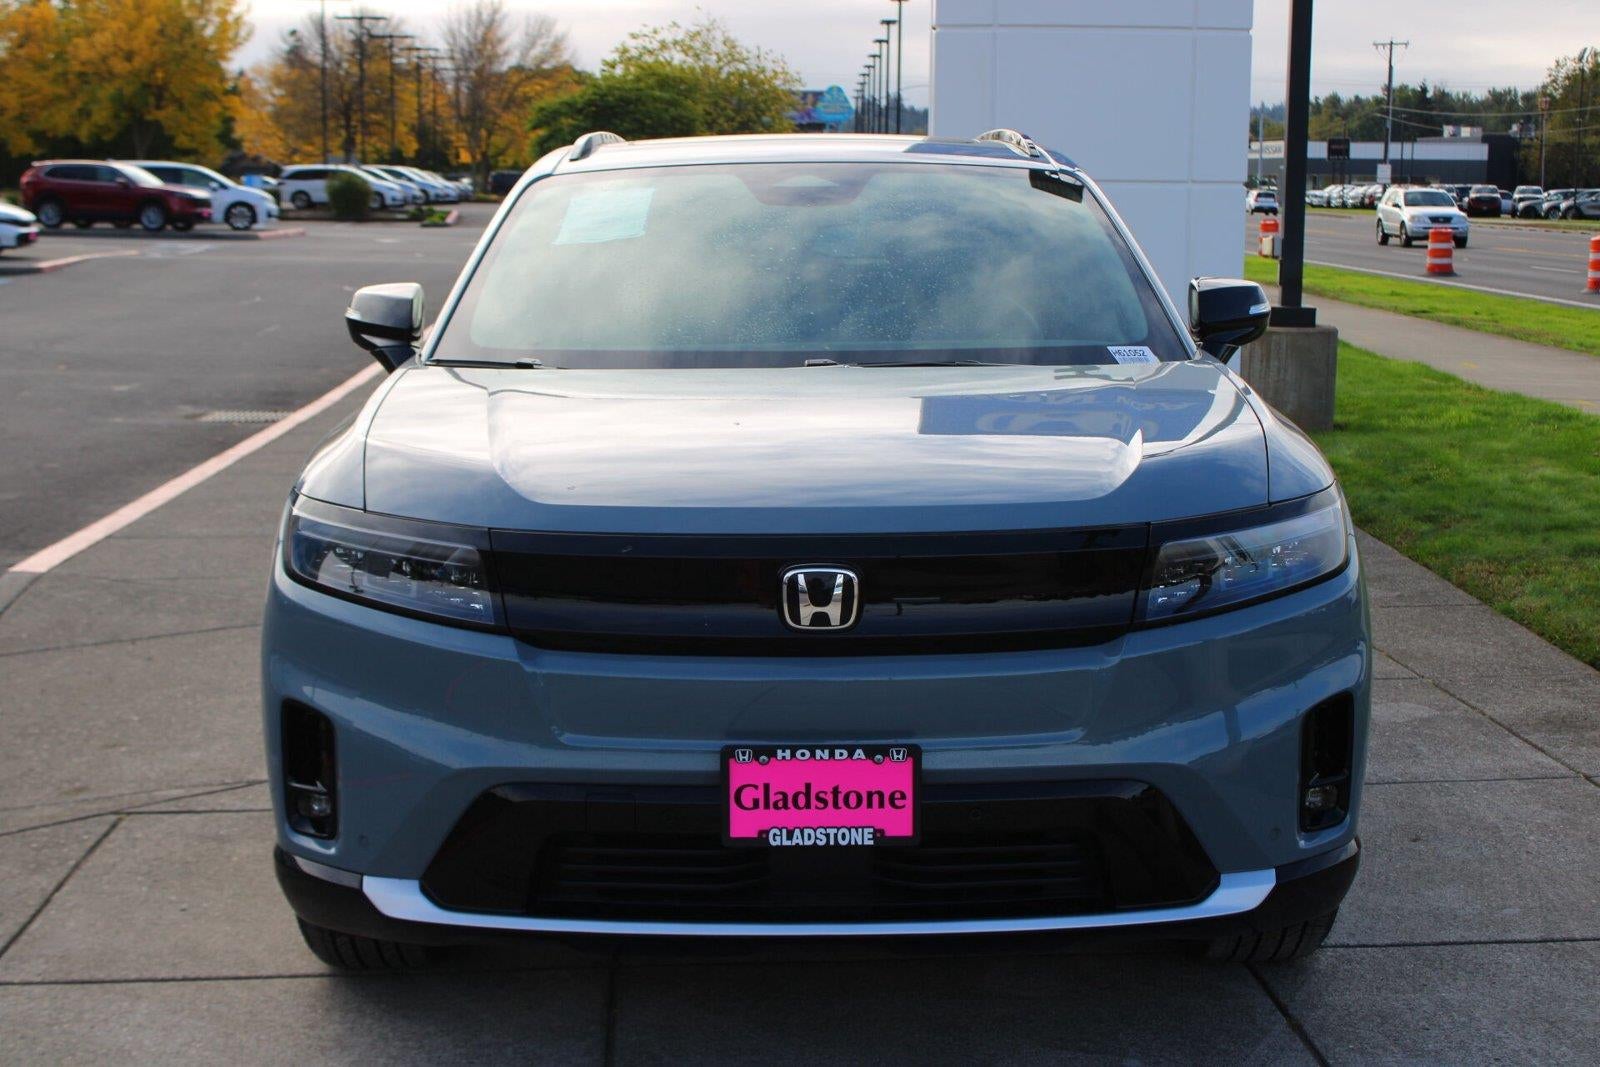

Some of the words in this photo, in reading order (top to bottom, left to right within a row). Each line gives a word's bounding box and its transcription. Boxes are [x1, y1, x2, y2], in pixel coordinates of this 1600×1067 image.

[776, 749, 867, 760] HONDA
[733, 783, 907, 811] Gladstone
[768, 828, 875, 846] GLADSTONE
